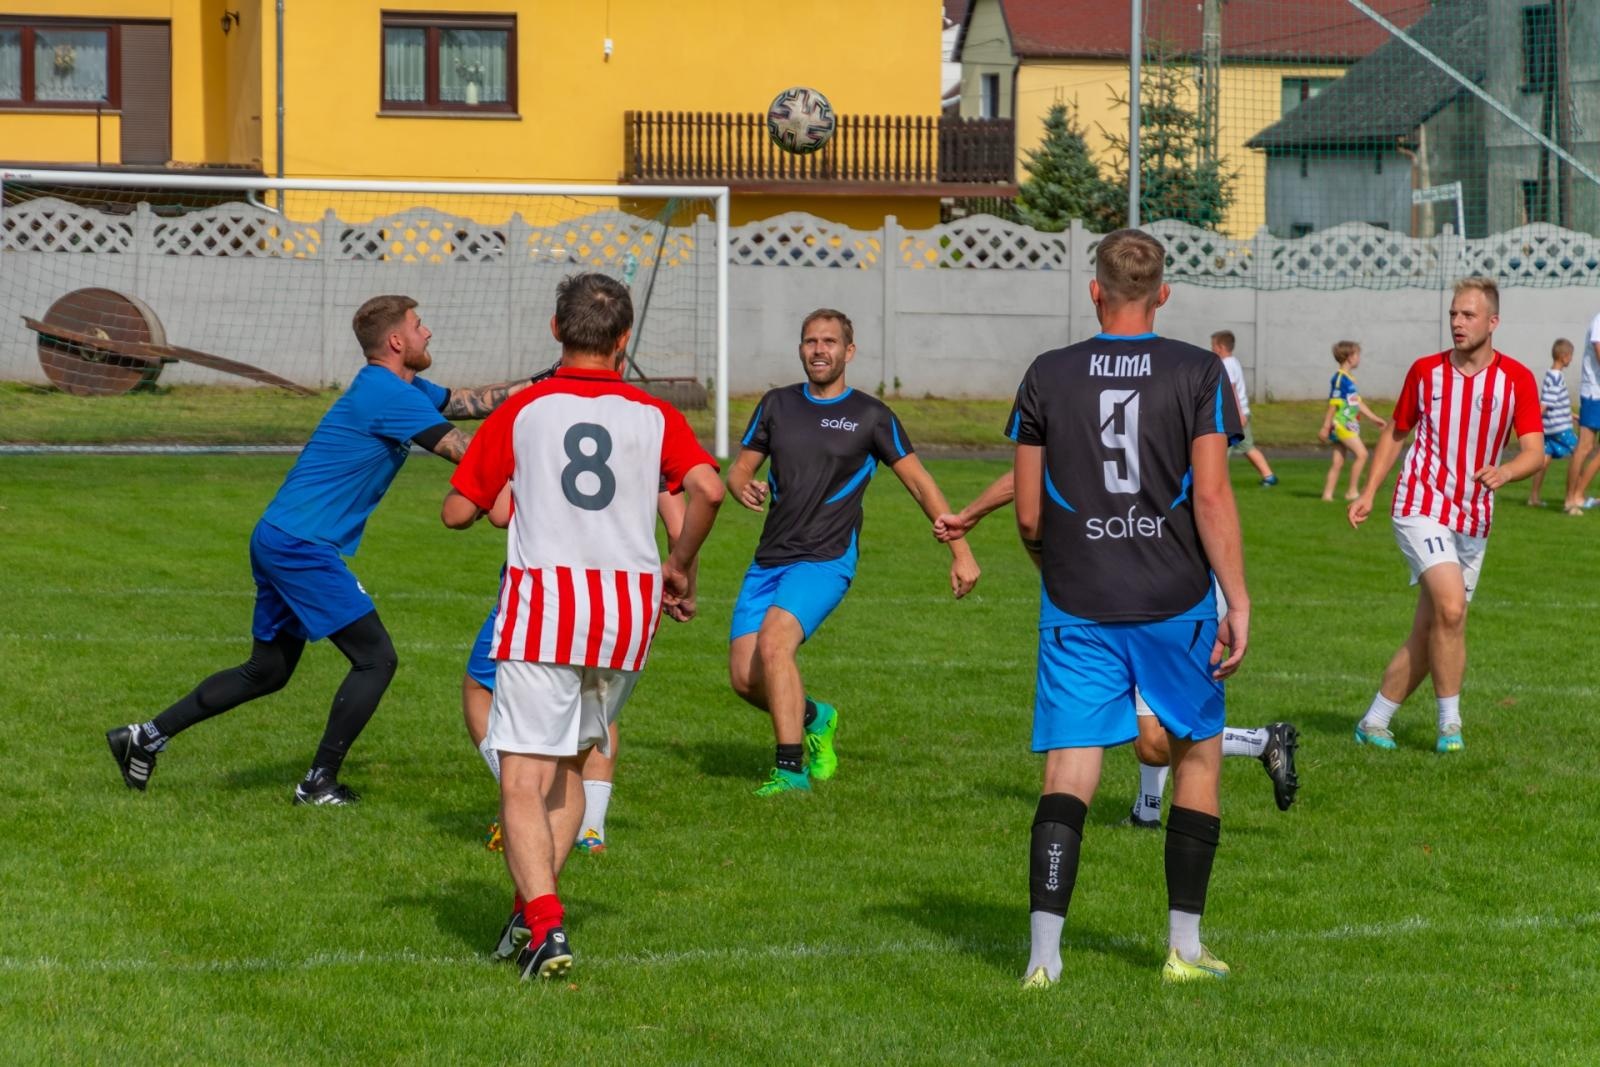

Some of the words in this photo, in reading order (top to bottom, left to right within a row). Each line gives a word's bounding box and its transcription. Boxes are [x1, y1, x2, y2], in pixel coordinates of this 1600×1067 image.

[1089, 353, 1151, 377] KLIMA
[820, 417, 859, 432] safer
[1100, 389, 1141, 494] 9
[561, 422, 616, 511] 8
[1086, 505, 1166, 540] safer
[1424, 536, 1445, 554] 11
[1045, 843, 1063, 891] TWORKOW
